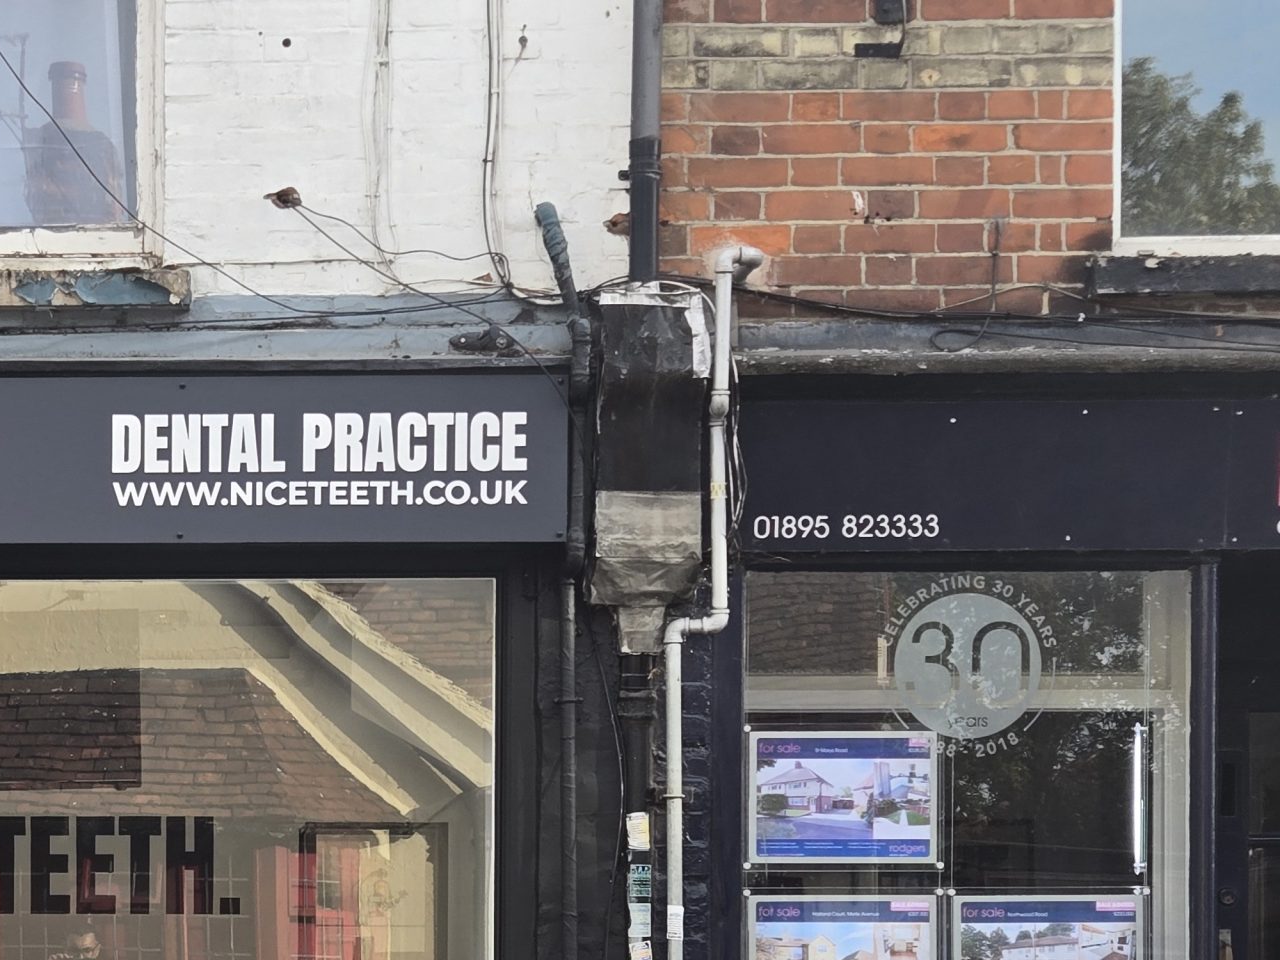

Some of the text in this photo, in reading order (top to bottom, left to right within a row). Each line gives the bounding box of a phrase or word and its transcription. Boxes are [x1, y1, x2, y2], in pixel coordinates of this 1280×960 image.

[111, 411, 528, 474] DENTAL PRACTICE
[113, 480, 528, 507] WWW.NICETEETH.CO.UK
[753, 513, 940, 539] 01895 823333
[884, 574, 1057, 649] CELEBRATING 30 YEARS
[905, 620, 1031, 709] 30
[758, 743, 801, 754] for sale
[975, 732, 1020, 758] 2018
[776, 906, 800, 917] sale
[962, 906, 1005, 918] for sale
